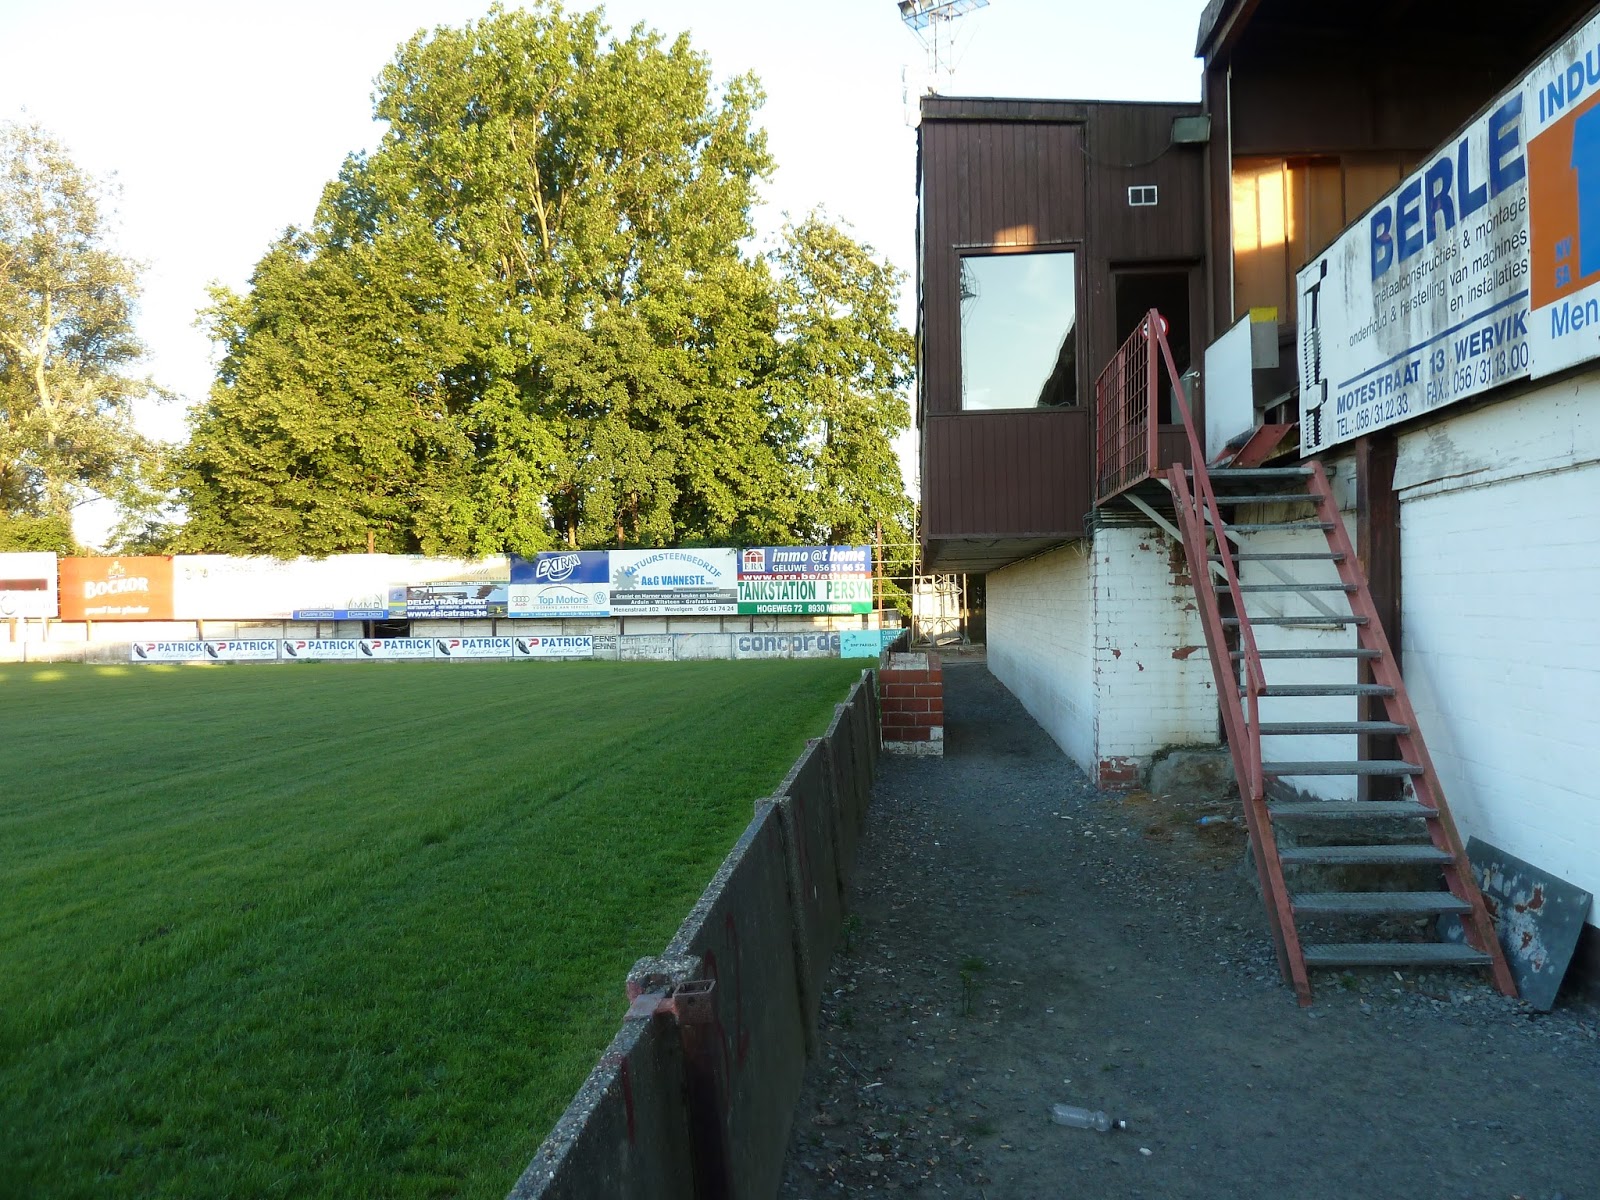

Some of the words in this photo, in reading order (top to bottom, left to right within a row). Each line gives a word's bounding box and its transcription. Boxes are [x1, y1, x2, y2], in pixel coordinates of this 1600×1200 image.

[1370, 91, 1526, 282] BERLE
[1374, 243, 1457, 307] metaalconstructies
[1463, 229, 1471, 249] &
[1475, 196, 1526, 241] montage
[1554, 265, 1570, 289] SA
[1349, 313, 1387, 347] onderhoud
[1390, 305, 1397, 323] &
[1400, 278, 1445, 317] herstelling
[1450, 266, 1468, 287] van
[1473, 229, 1527, 275] machines
[1450, 295, 1464, 312] en
[1468, 258, 1528, 303] installaties
[1337, 359, 1421, 415] MOTESTRAAT
[1429, 349, 1445, 375] 13
[1455, 309, 1528, 364] WERVIK
[1453, 341, 1529, 394] 056/31.13.00
[772, 548, 808, 562] immo
[811, 549, 828, 562] @t
[829, 548, 865, 562] home
[536, 554, 581, 578] EXTRAN
[624, 552, 722, 578] NATUURSTEENBEDRIJF
[744, 562, 763, 570] ERA
[772, 564, 807, 572] GELUWE
[831, 564, 840, 572] 51
[641, 576, 659, 585] A&G
[661, 575, 705, 585] VANNESTE
[743, 572, 866, 580] www.era.be/athome
[738, 581, 816, 600] TANKSTATION
[826, 580, 871, 599] PERSYN
[538, 596, 551, 605] Top
[556, 595, 588, 604] Motors
[407, 609, 487, 617] www.delcatrans.be
[757, 604, 793, 613] HOGEWEG
[794, 604, 802, 613] 72
[808, 604, 825, 613] 8930
[158, 642, 203, 652] PATRICK
[229, 641, 275, 651] PATRICK
[308, 640, 355, 650] PATRICK
[384, 640, 431, 649] PATRICK
[462, 639, 511, 648] PATRICK
[541, 637, 591, 647] PATRICK
[738, 632, 840, 652] concorde
